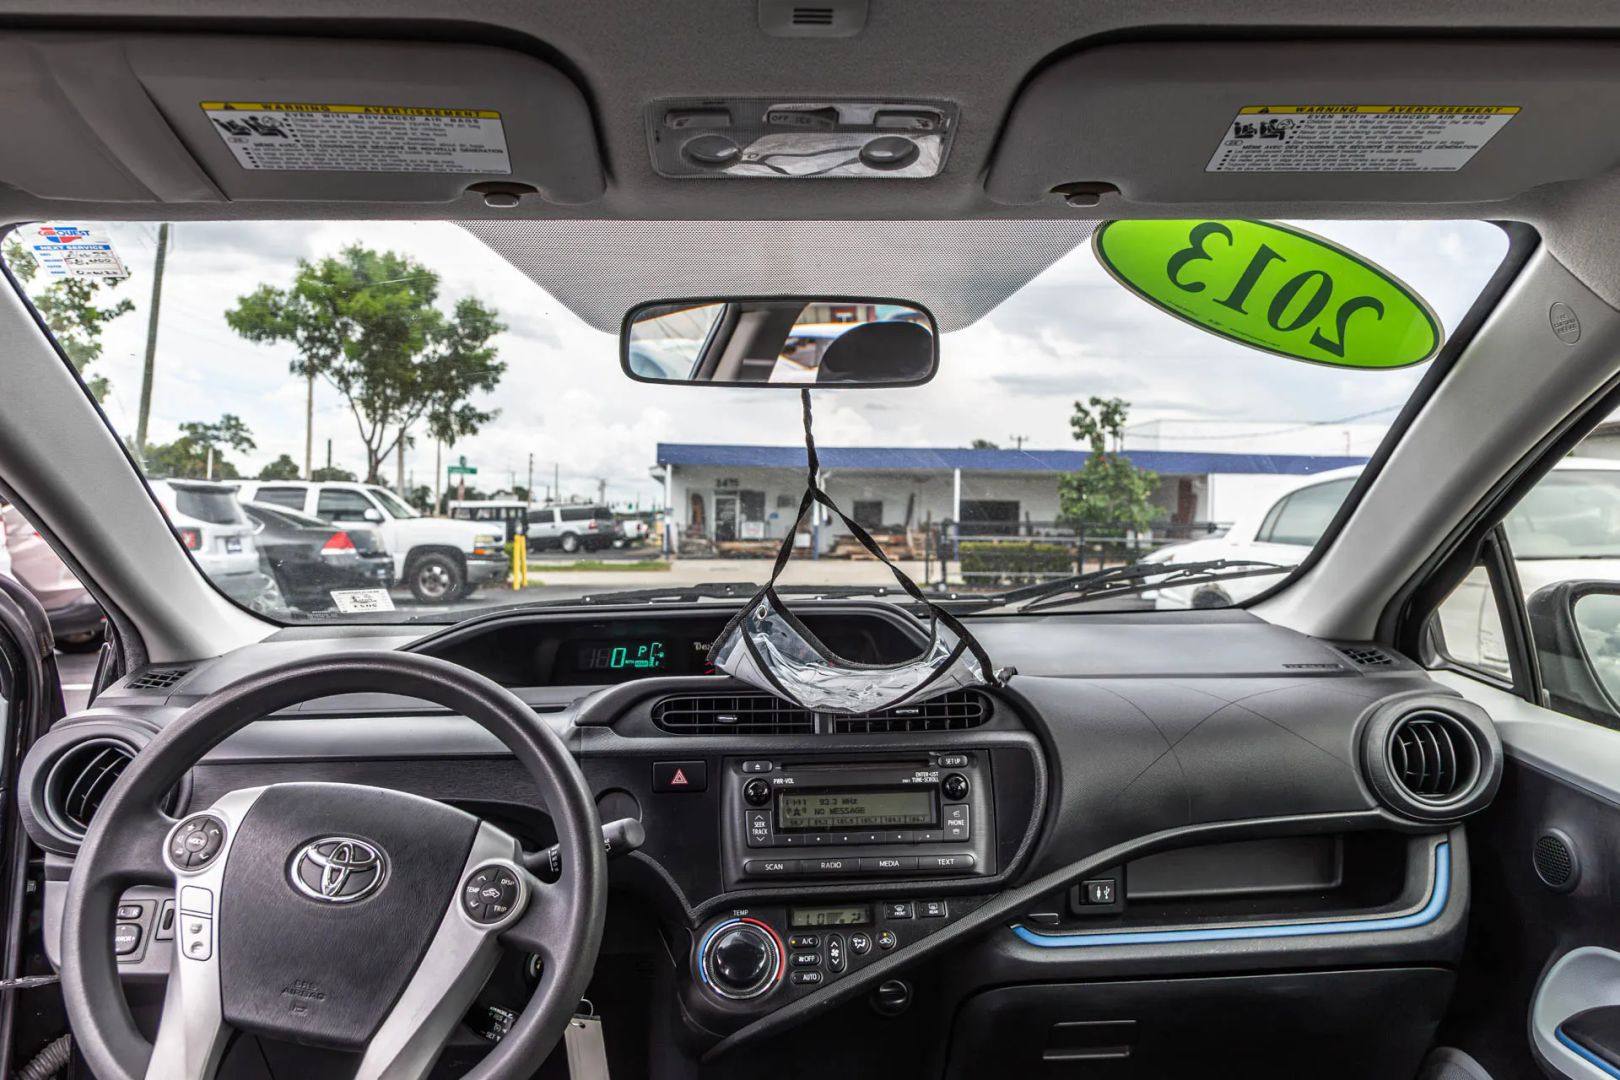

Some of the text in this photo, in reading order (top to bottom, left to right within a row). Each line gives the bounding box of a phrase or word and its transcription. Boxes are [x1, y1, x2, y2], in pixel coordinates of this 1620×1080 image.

[261, 103, 480, 118] WARNING AVERTISSEMENT
[1387, 106, 1503, 114] AVERTISSEMENT
[638, 645, 647, 657] P
[610, 647, 627, 668] 0
[820, 861, 842, 869] RADIO
[937, 858, 955, 866] TEXT
[764, 863, 784, 871] SCAN
[733, 909, 749, 917] TEMP
[280, 987, 324, 1000] AIRBAG
[486, 1031, 496, 1040] SET
